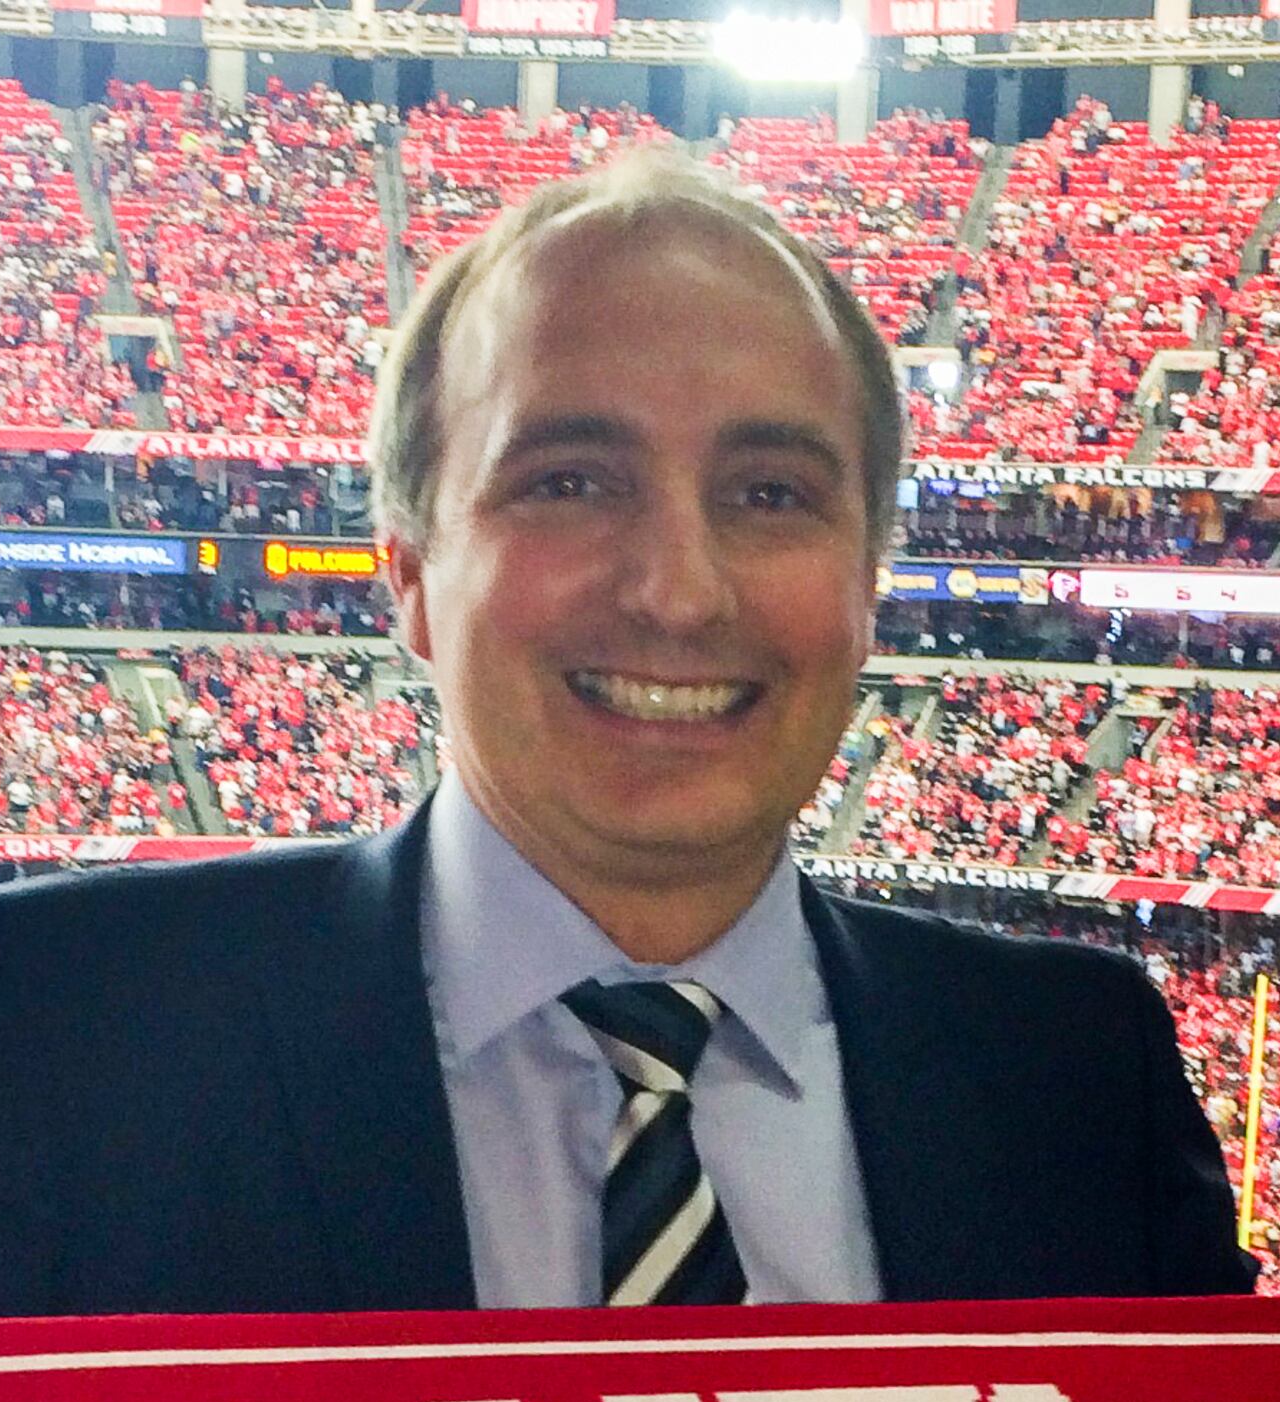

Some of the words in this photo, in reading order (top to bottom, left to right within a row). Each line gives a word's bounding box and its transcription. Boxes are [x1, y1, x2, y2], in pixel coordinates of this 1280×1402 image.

[147, 435, 291, 459] ATLANTA
[912, 463, 1055, 486] ATLANTA
[1064, 467, 1207, 489] FALCONS
[905, 862, 1050, 891] FALCONS
